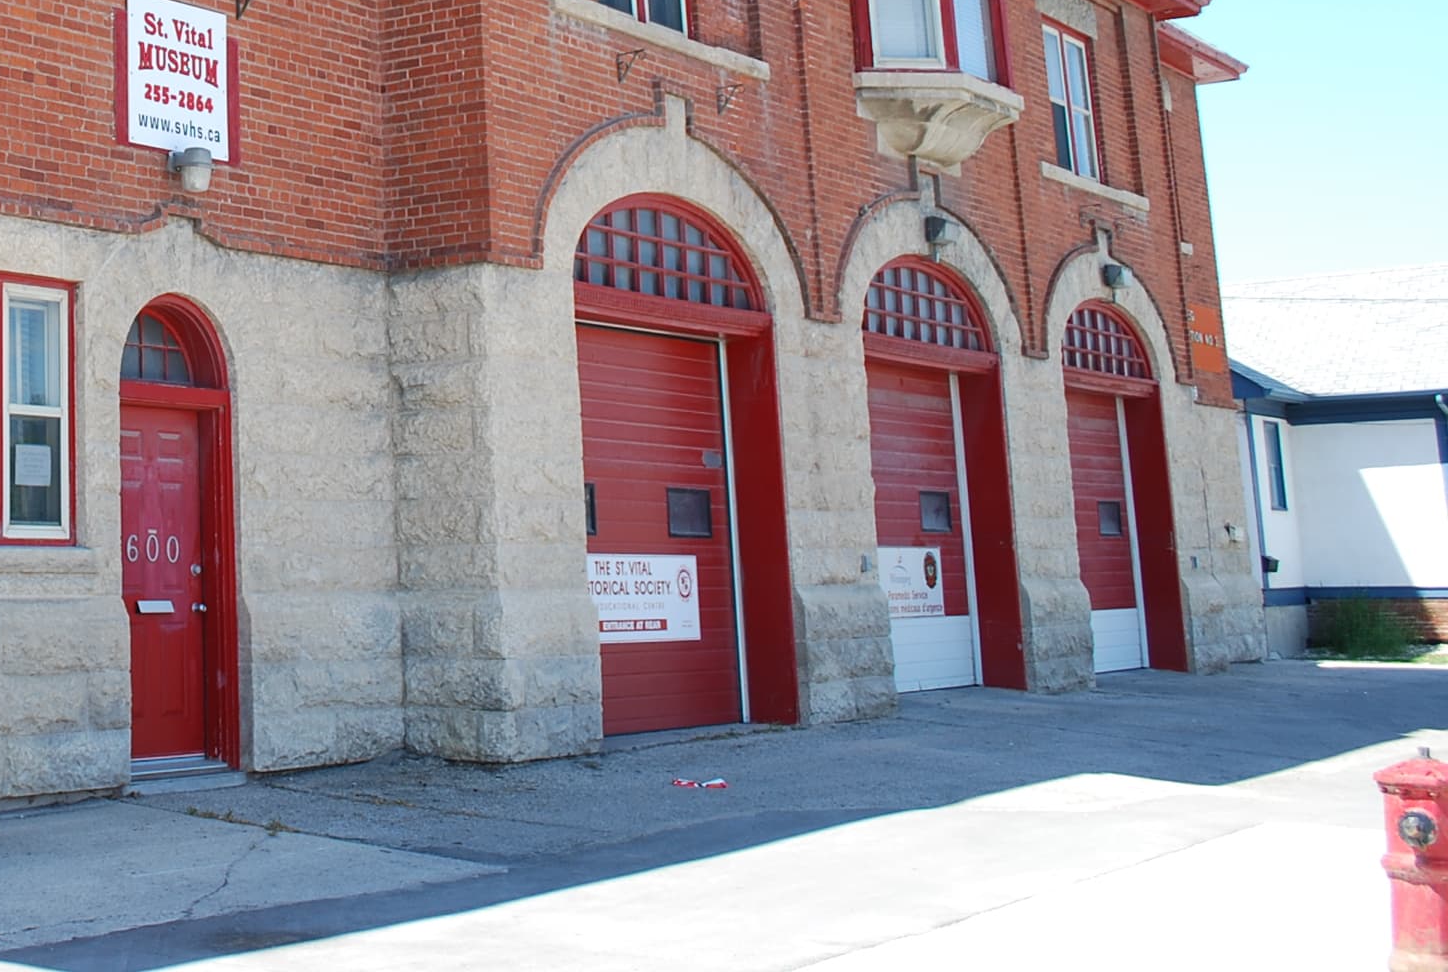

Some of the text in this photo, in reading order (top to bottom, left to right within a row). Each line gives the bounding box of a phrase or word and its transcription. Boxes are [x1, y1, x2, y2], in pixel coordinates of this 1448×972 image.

[144, 12, 213, 50] St. Vital
[138, 41, 219, 88] MUSEUM
[144, 83, 214, 114] 255-2864
[138, 113, 221, 143] www.svhs.ca
[126, 534, 180, 564] 600
[594, 561, 611, 576] THE
[629, 561, 653, 576] VITAL
